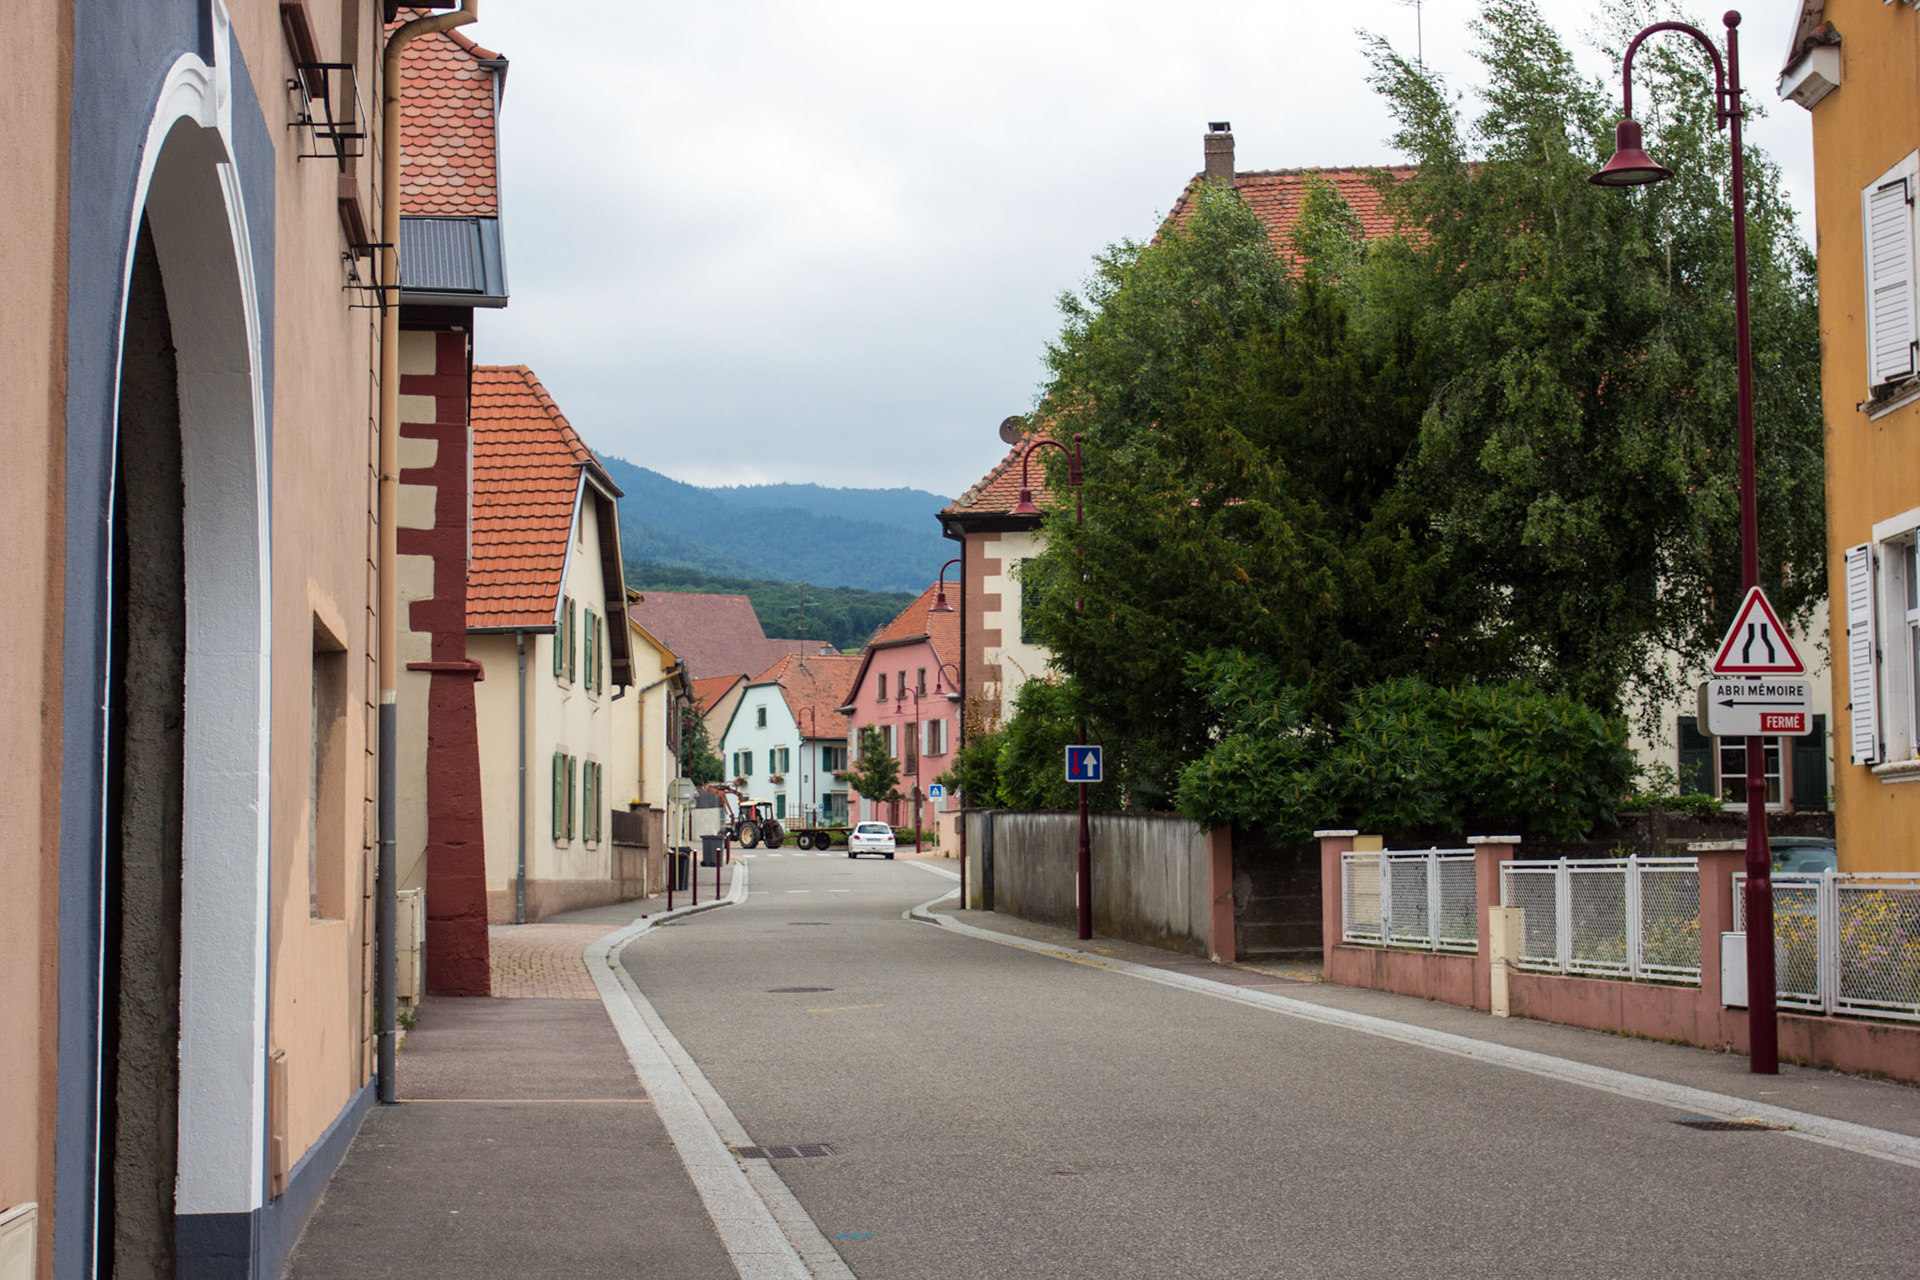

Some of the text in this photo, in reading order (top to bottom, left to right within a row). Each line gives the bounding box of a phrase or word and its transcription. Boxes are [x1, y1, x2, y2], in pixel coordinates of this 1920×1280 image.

[1717, 683, 1803, 696] ABRI MÉMOIRE
[1766, 714, 1800, 728] FERMÉ
